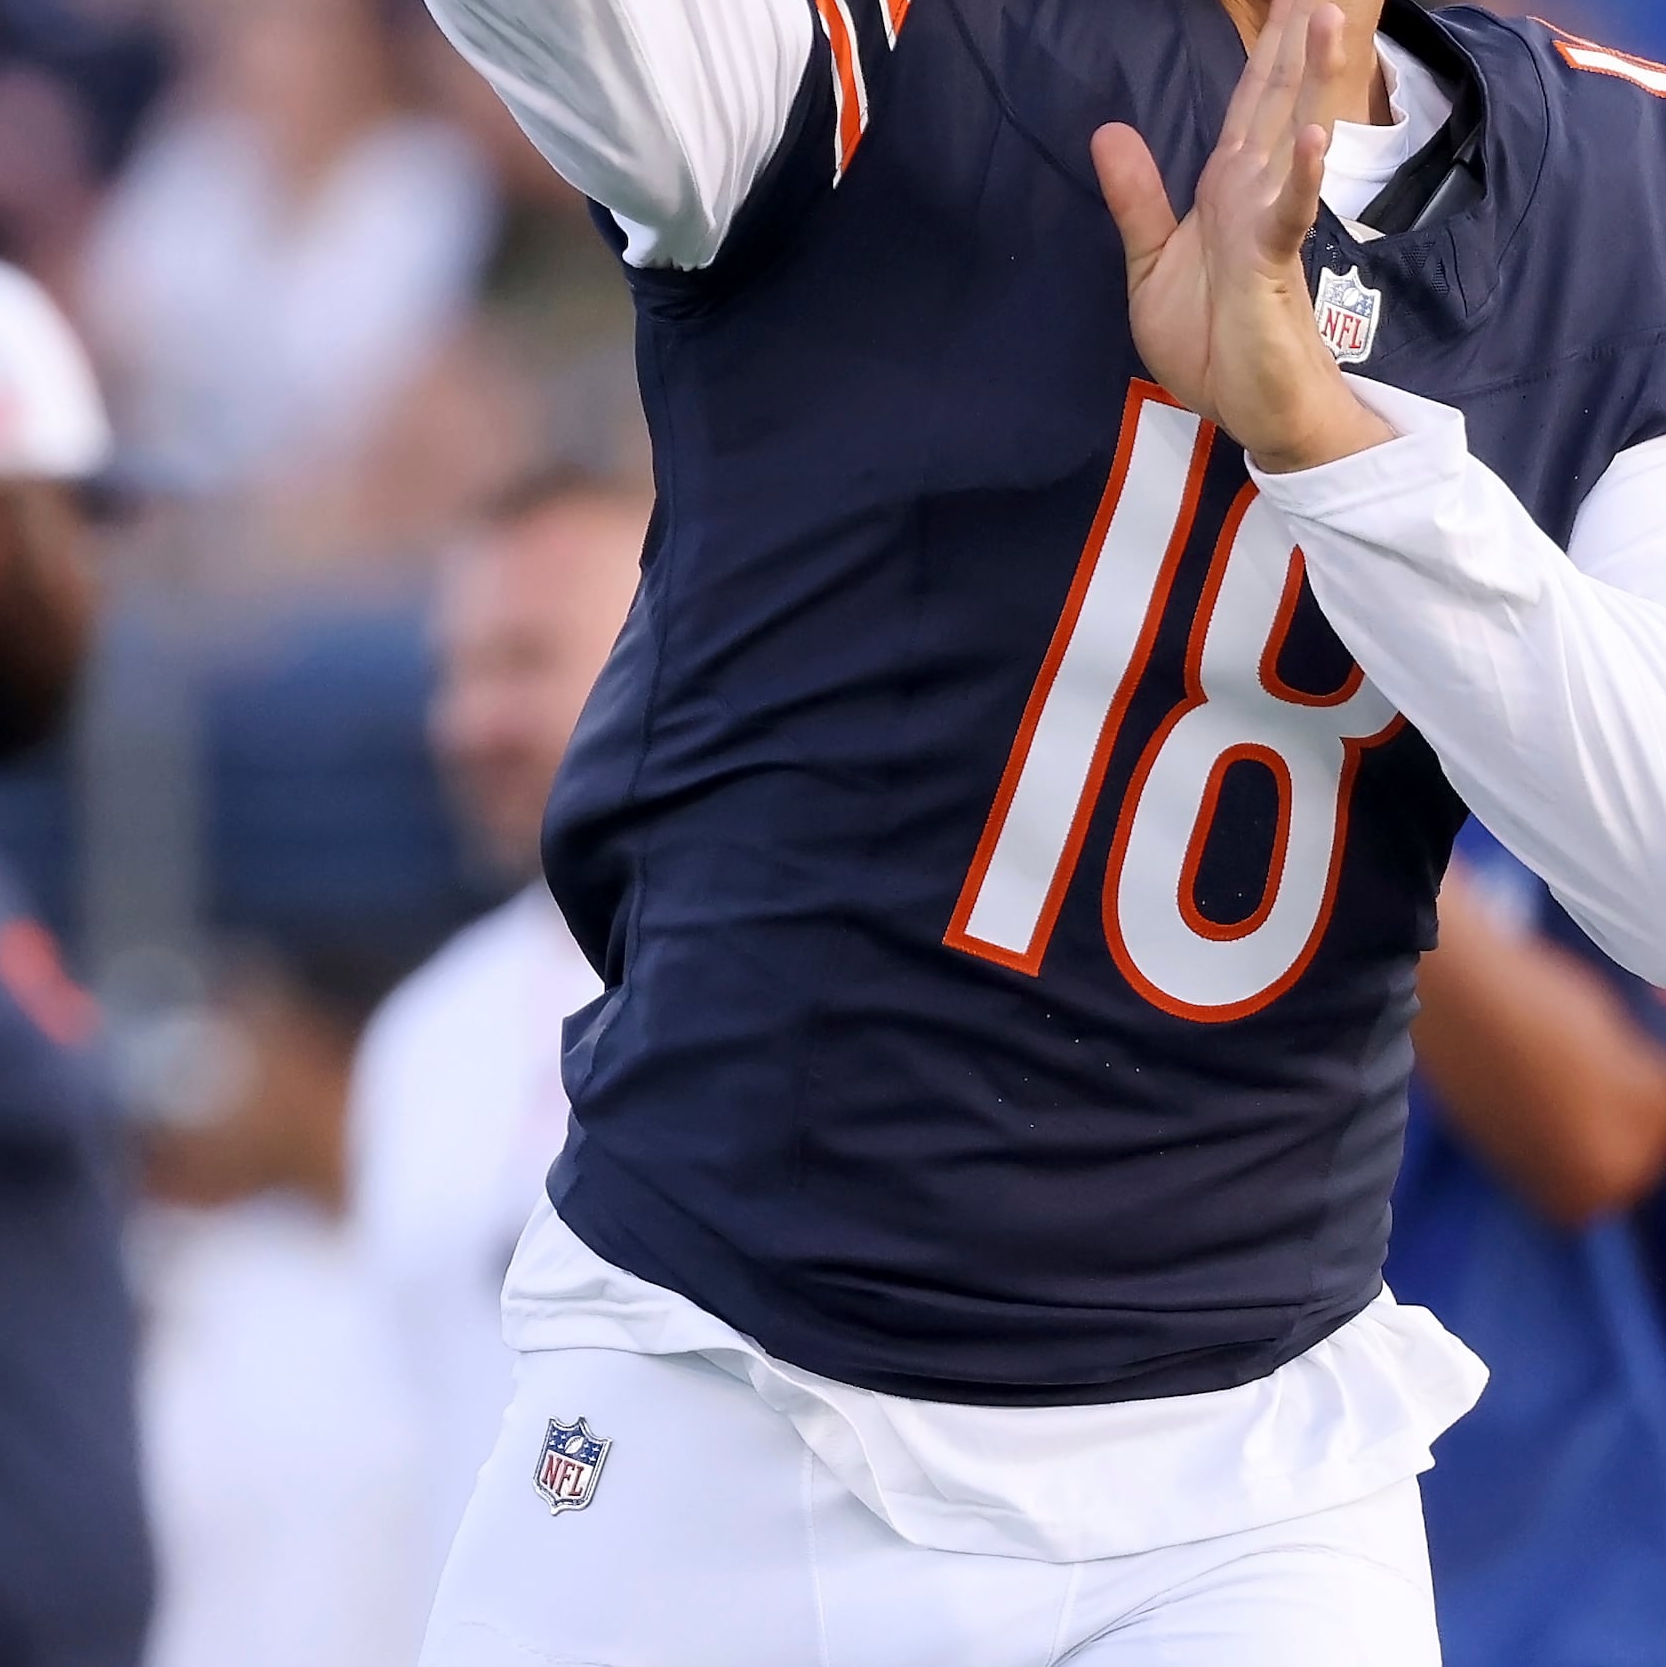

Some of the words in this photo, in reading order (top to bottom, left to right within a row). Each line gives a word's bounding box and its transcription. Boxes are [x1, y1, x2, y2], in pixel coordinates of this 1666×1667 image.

[1320, 307, 1363, 350] NFL
[942, 377, 1403, 1023] 18
[540, 1453, 586, 1498] NFL
